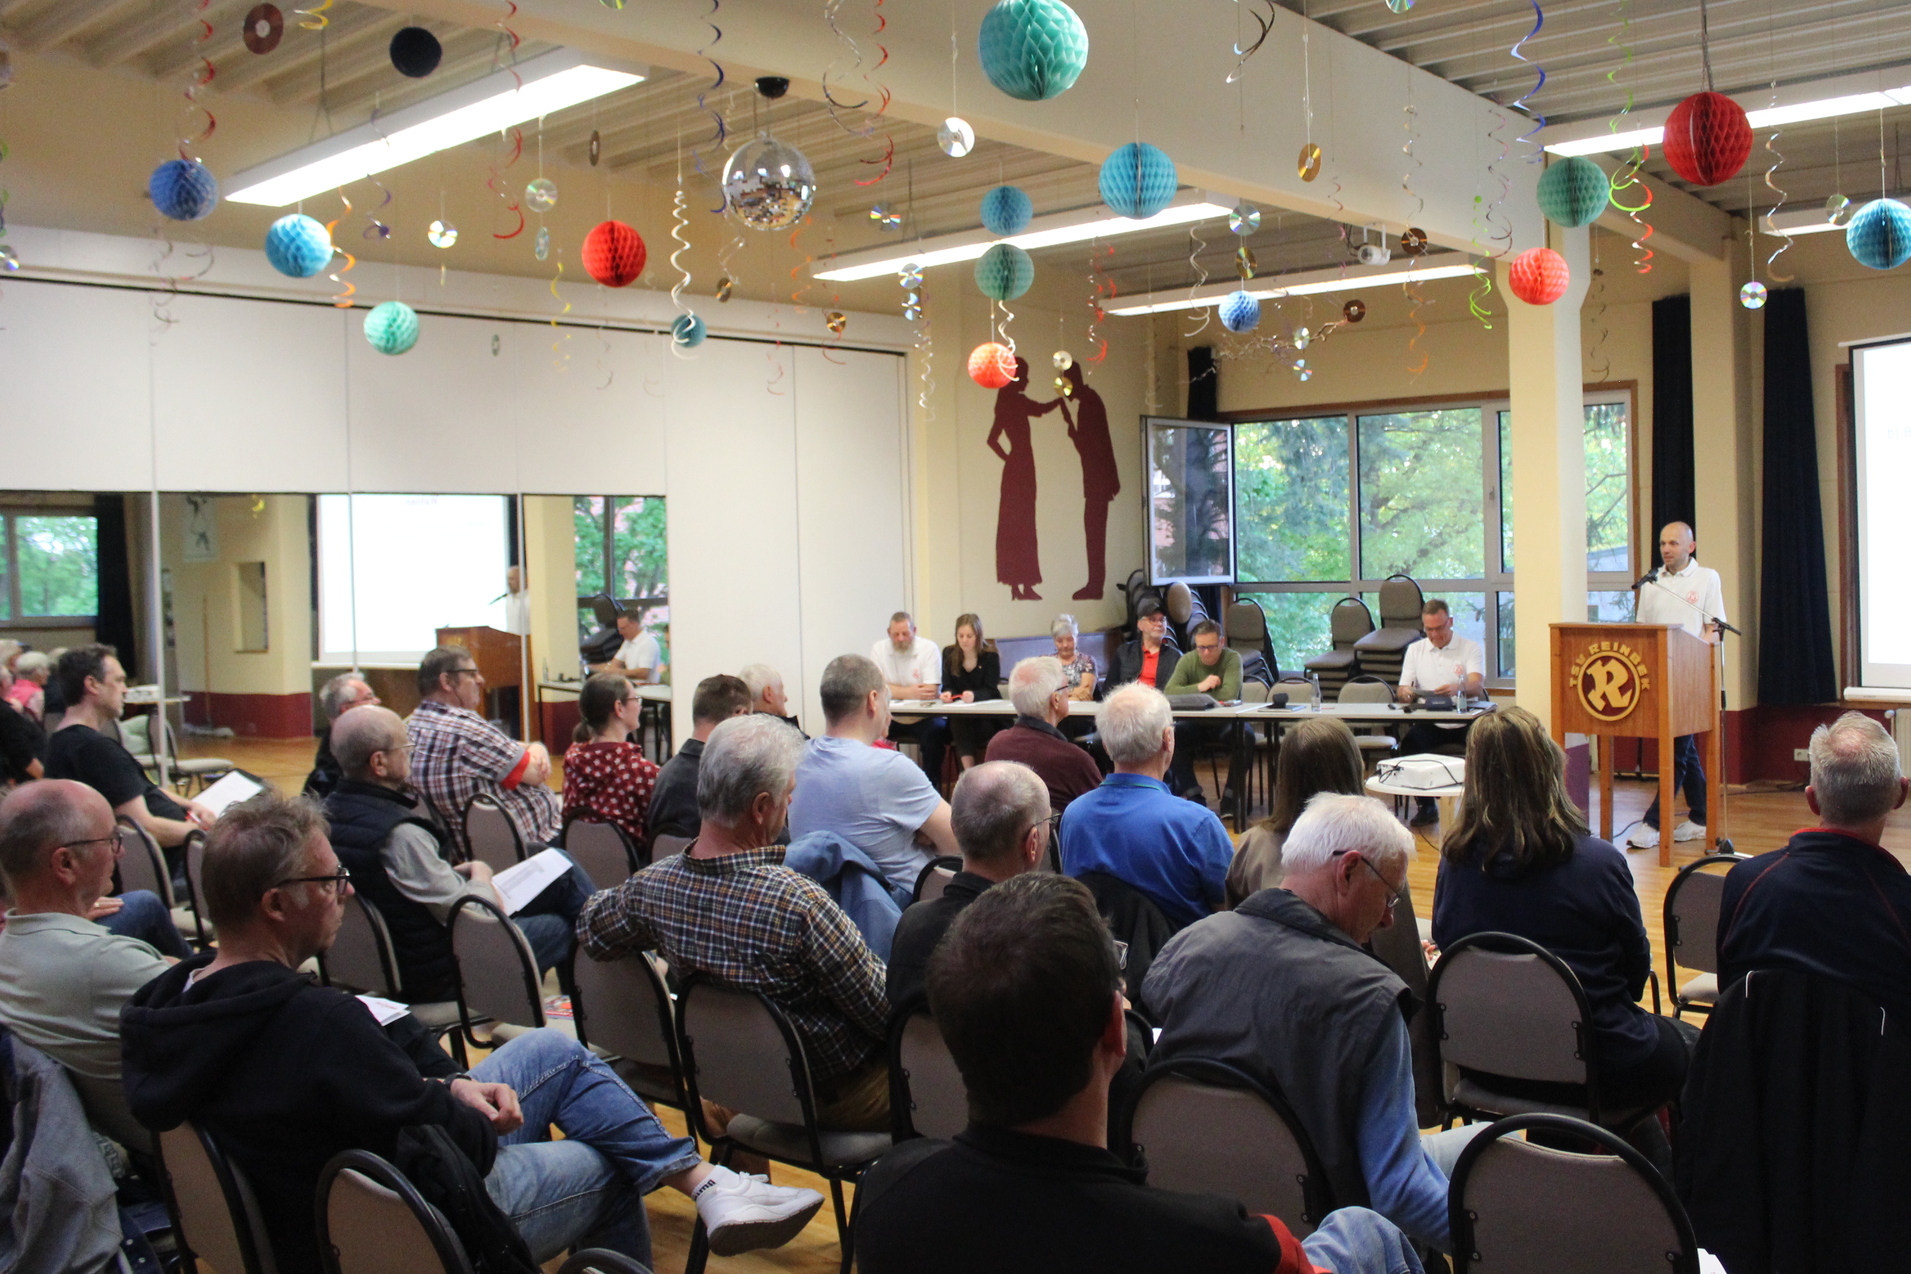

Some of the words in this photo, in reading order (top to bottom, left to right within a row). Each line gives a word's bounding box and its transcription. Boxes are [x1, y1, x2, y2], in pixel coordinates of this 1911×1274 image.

[1569, 653, 1587, 687] TSV
[1588, 641, 1650, 691] REINBEK
[1586, 658, 1633, 712] R
